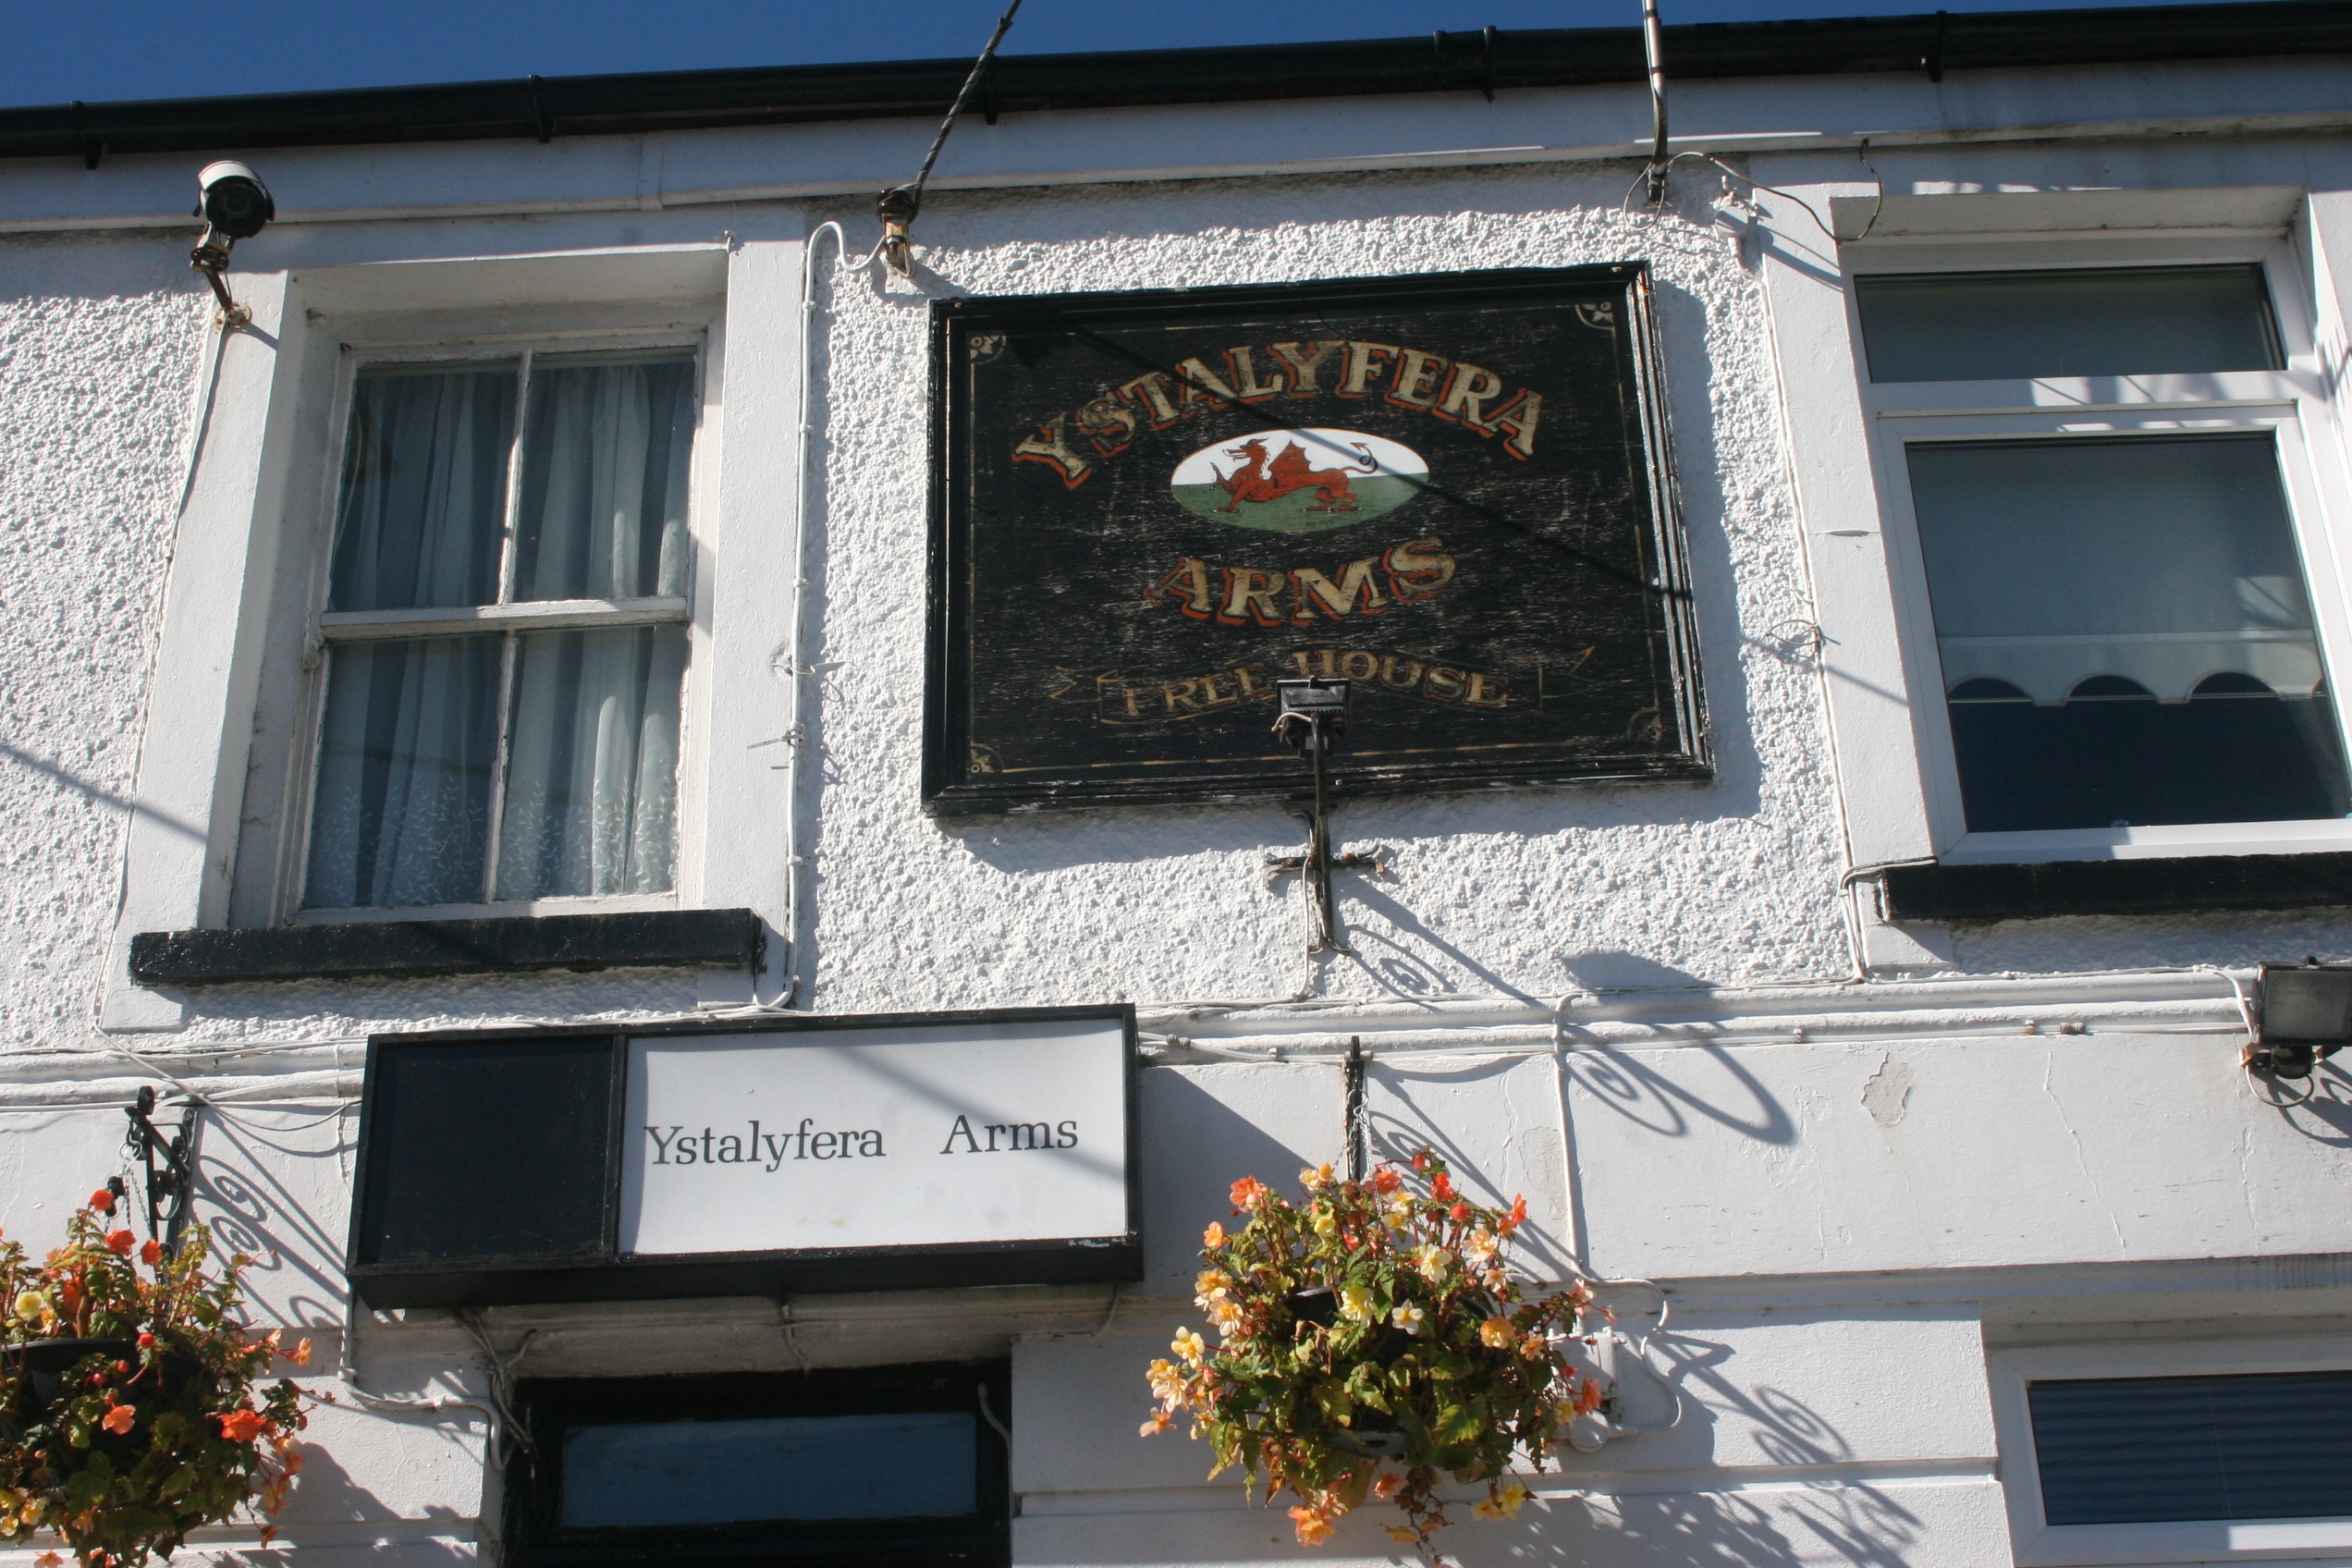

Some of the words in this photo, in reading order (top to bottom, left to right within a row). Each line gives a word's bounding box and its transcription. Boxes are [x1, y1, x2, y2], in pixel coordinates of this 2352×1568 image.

[1013, 340, 1543, 489] YSTALYFERA
[1144, 536, 1457, 627] ARMS
[1120, 664, 1274, 718] FREE
[1292, 648, 1510, 709] HOUSE
[643, 1118, 887, 1172] Ystalyfera
[939, 1114, 1079, 1155] Arms
